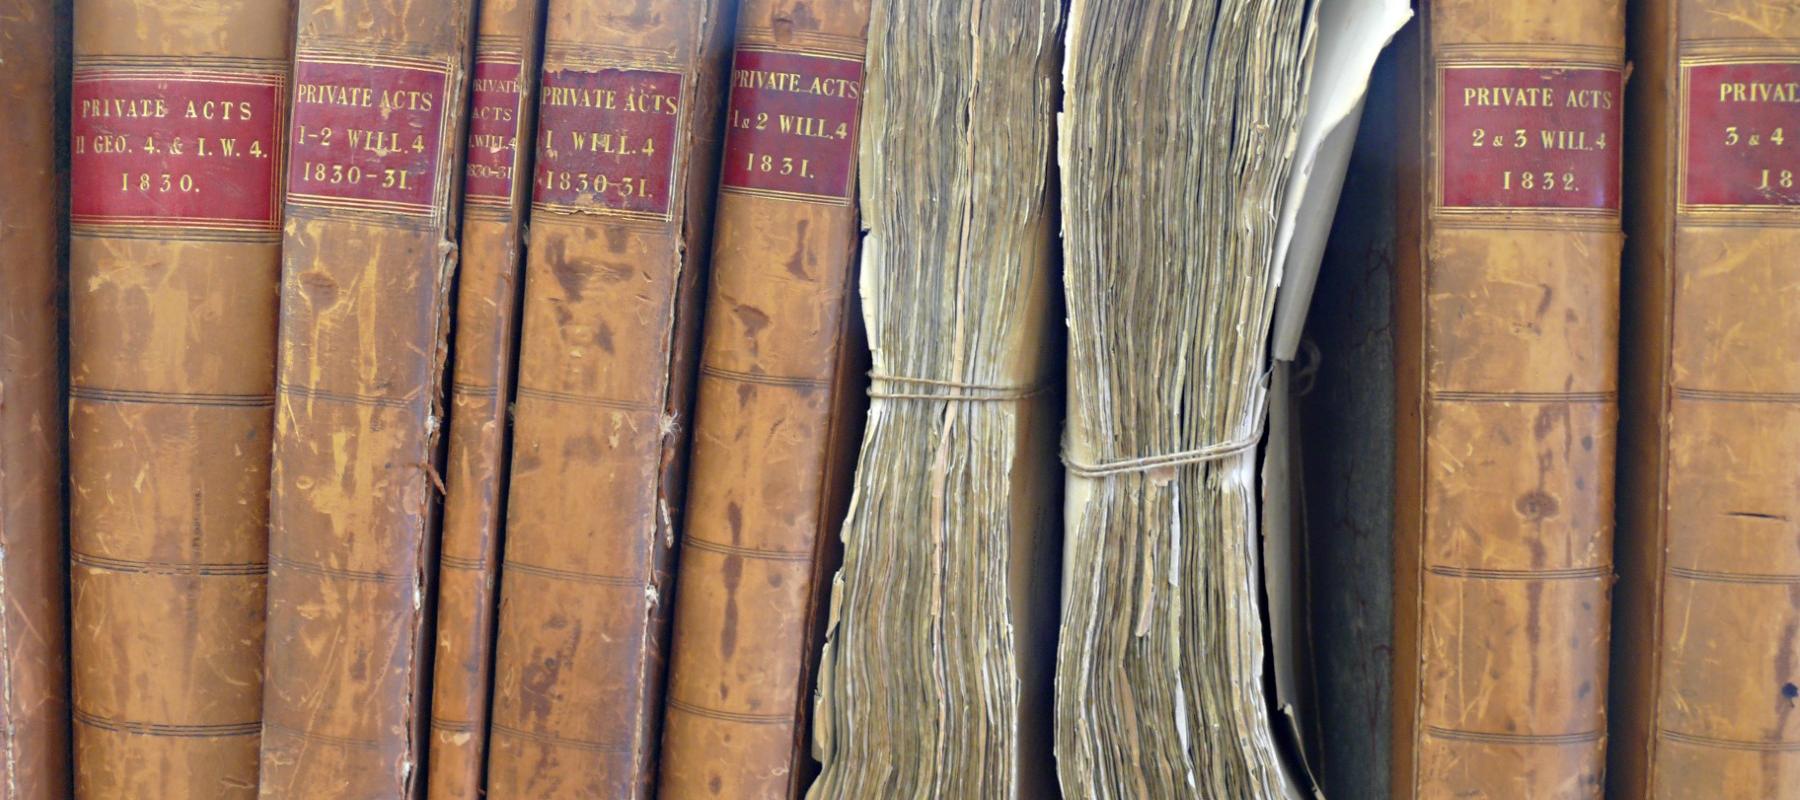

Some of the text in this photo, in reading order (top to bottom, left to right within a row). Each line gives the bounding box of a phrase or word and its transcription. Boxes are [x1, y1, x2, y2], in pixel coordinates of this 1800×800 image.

[733, 69, 860, 99] PRIVATE ACTS
[1720, 82, 1800, 103] PRIVAT
[297, 84, 433, 112] PRIVATE ACTS
[542, 86, 678, 116] PRIVATE ACTS
[1463, 87, 1613, 110] PRIVATE ACTS
[82, 98, 253, 121] PRIVATE ACTS
[472, 106, 513, 121] ACTS
[741, 117, 750, 129] &
[755, 112, 769, 131] 2
[93, 135, 133, 154] GEO.
[169, 136, 184, 155] &
[1472, 128, 1485, 147] 2
[1492, 135, 1503, 147] &
[1514, 128, 1528, 148] 3
[1724, 126, 1785, 146] 3 & 4
[121, 172, 201, 193] 1830.
[1503, 170, 1580, 192] 1832.
